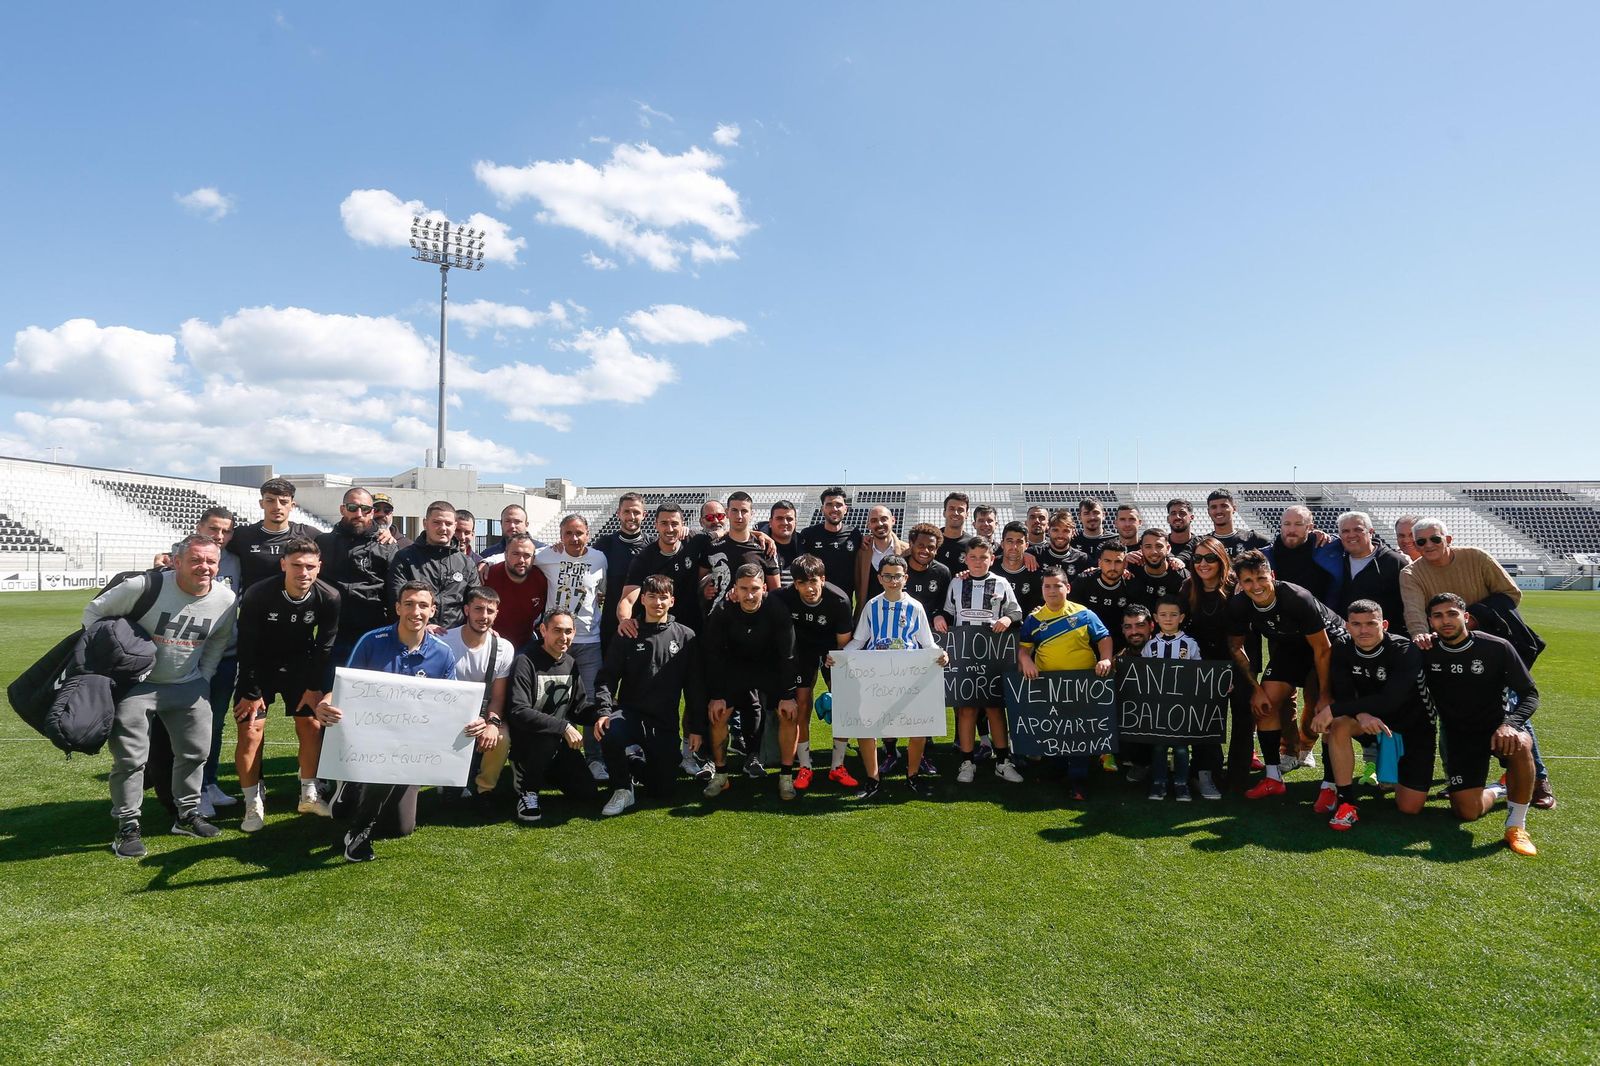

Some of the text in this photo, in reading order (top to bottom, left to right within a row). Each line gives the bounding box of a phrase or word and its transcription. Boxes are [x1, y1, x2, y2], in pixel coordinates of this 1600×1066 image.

[270, 545, 280, 554] 17
[560, 561, 592, 575] SPORT
[63, 575, 109, 587] hummel
[291, 614, 297, 622] 8
[805, 613, 814, 622] 19
[154, 612, 211, 640] HH
[966, 662, 987, 675] mis
[1450, 664, 1463, 674] 26
[346, 680, 424, 701] SIEMPRE
[944, 676, 1002, 701] MORE
[1006, 676, 1115, 706] VENIMOS
[1049, 705, 1059, 717] A
[1118, 700, 1225, 733] BALONA
[353, 710, 431, 727] VOSOTROS
[1016, 716, 1110, 735] APOYARTE
[1451, 775, 1463, 786] 26
